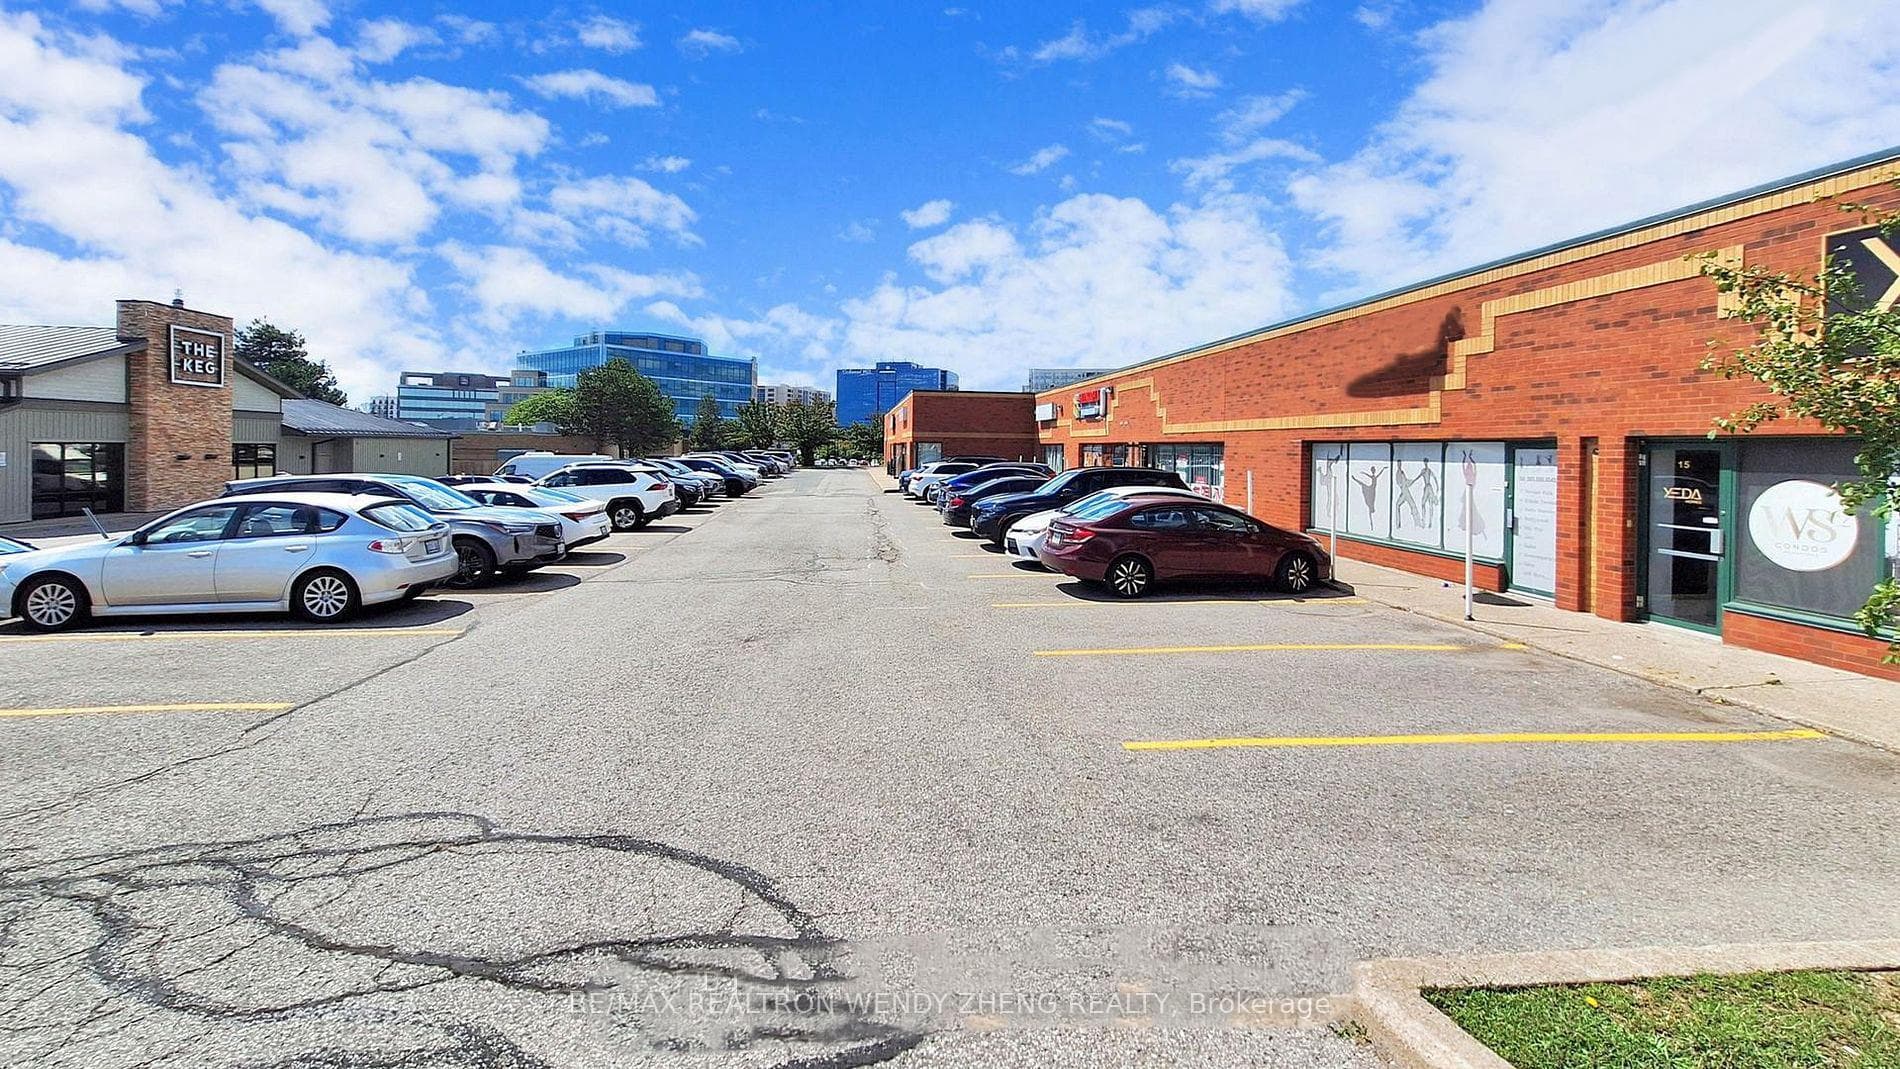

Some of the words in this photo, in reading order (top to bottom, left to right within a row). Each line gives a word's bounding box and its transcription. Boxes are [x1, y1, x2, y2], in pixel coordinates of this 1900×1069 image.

[181, 341, 216, 358] THE
[183, 358, 216, 374] KEG
[1677, 460, 1691, 469] 15
[1663, 487, 1702, 501] YEDA
